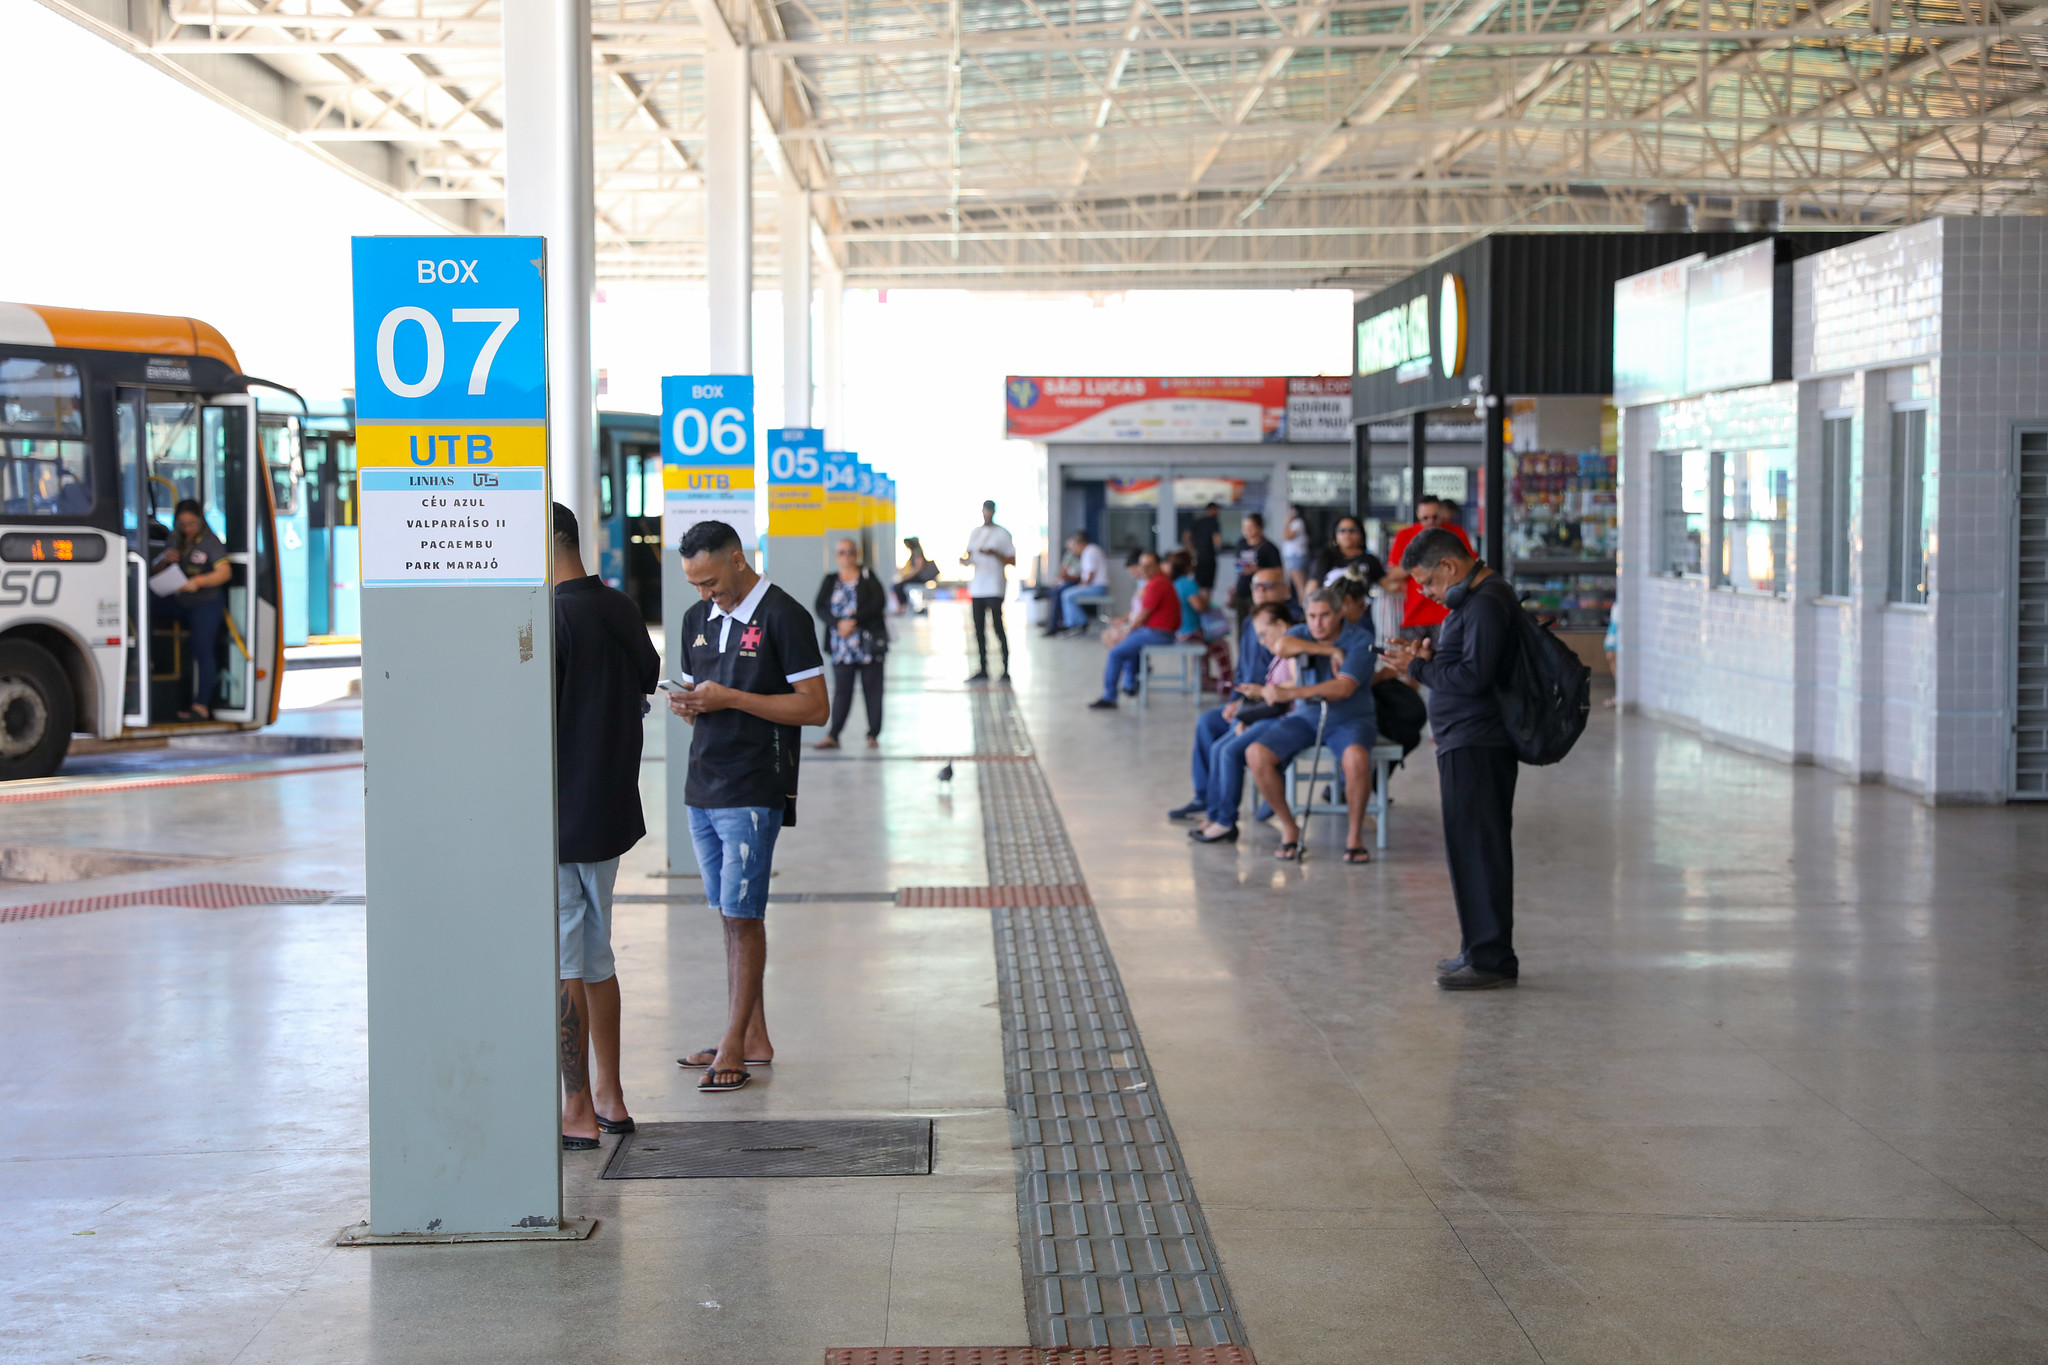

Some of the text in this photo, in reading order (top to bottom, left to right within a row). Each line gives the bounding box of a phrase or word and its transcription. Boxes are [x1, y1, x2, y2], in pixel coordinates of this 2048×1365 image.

[417, 259, 479, 284] BOX
[376, 306, 520, 398] 07
[146, 365, 191, 381] ENTRADA
[692, 384, 724, 399] BOX
[1043, 378, 1146, 396] SÃO LUCAS
[672, 407, 747, 456] 06
[410, 434, 494, 466] UTB
[771, 446, 820, 479] 05
[409, 473, 499, 487] LINHAS UTB
[688, 474, 730, 490] UTB
[823, 463, 856, 489] 04
[421, 495, 485, 507] CÉU AZUL
[406, 516, 506, 528] VALPARAÍSO II
[420, 540, 493, 549] PACAEMBU
[405, 557, 498, 570] PARK MARAJÓ
[0, 570, 62, 605] SO
